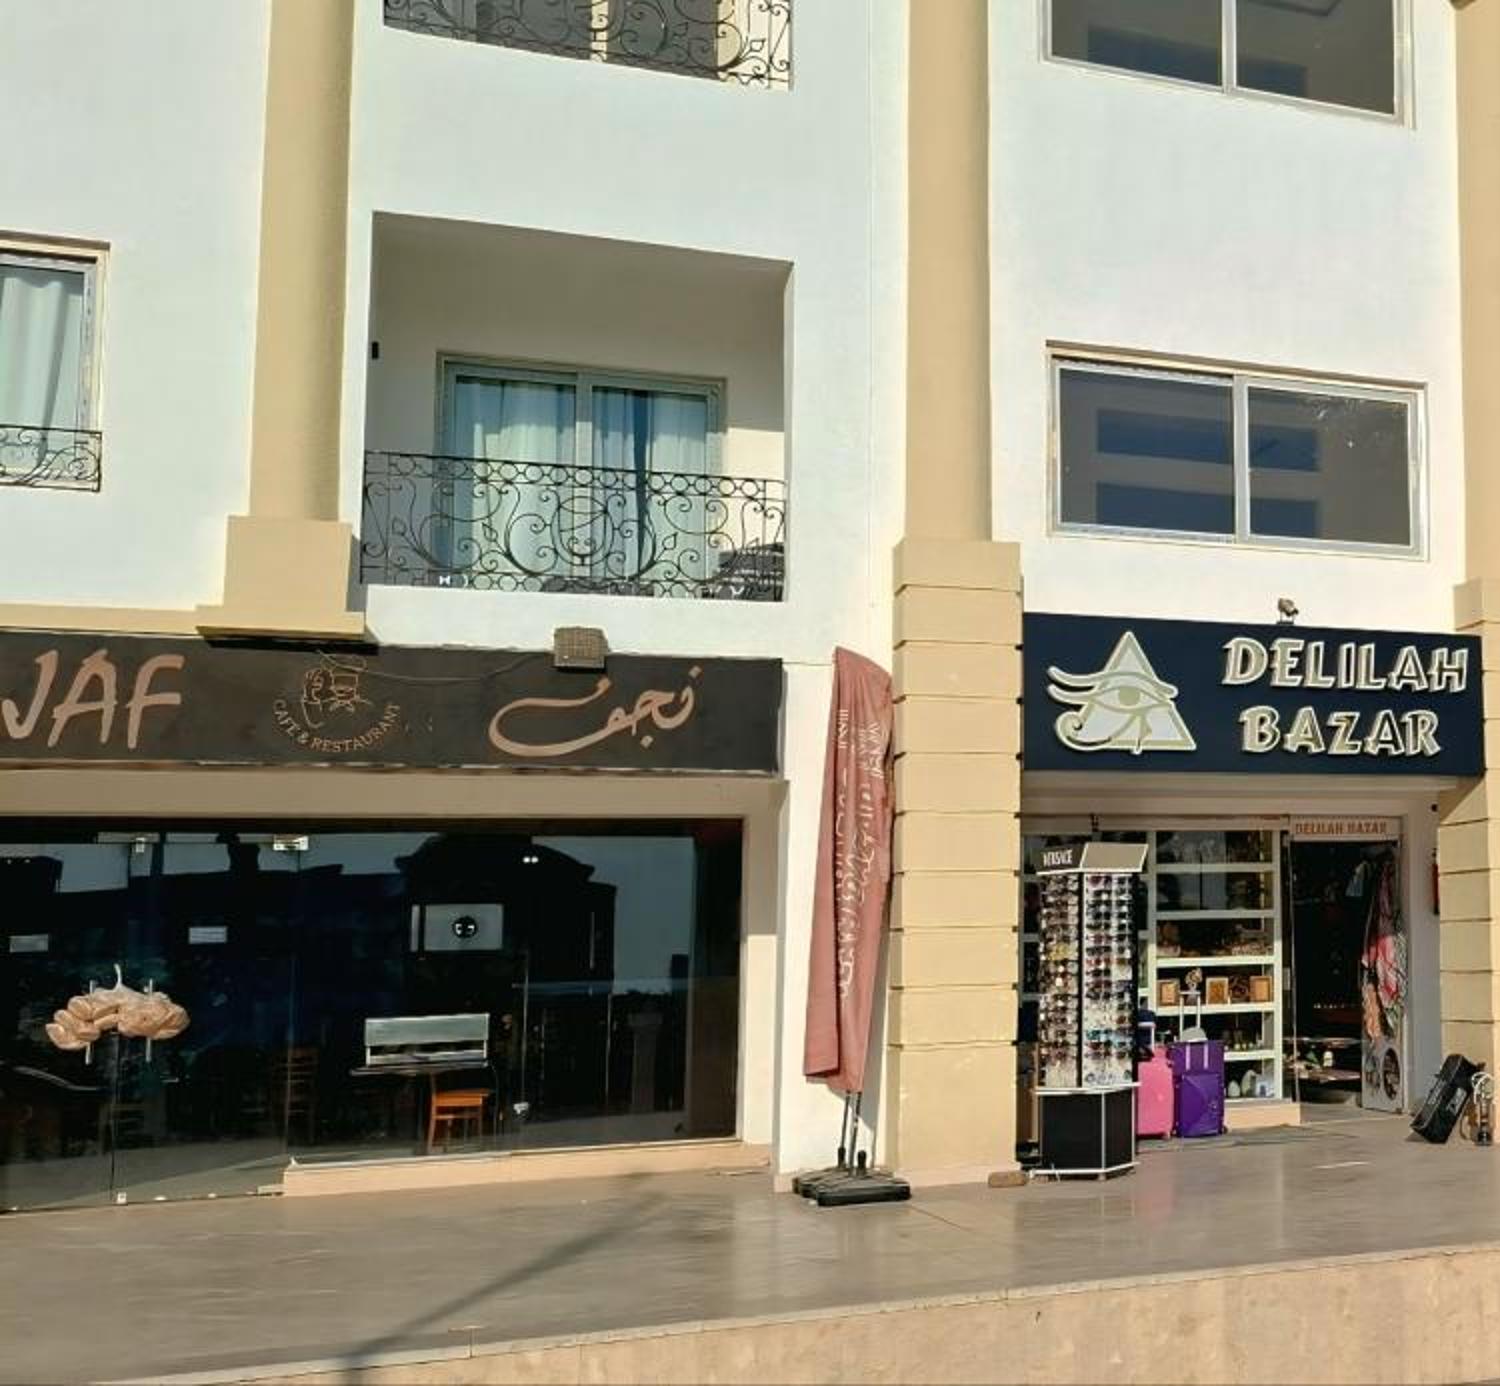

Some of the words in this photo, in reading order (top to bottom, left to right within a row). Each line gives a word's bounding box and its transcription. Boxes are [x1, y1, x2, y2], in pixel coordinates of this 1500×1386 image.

[1222, 637, 1469, 693] DELILAH
[1, 650, 185, 749] JAF
[489, 665, 702, 758] نجف
[310, 702, 401, 752] RESTAURANT
[1239, 705, 1442, 757] BAZAR
[1295, 823, 1343, 836] DELILAH
